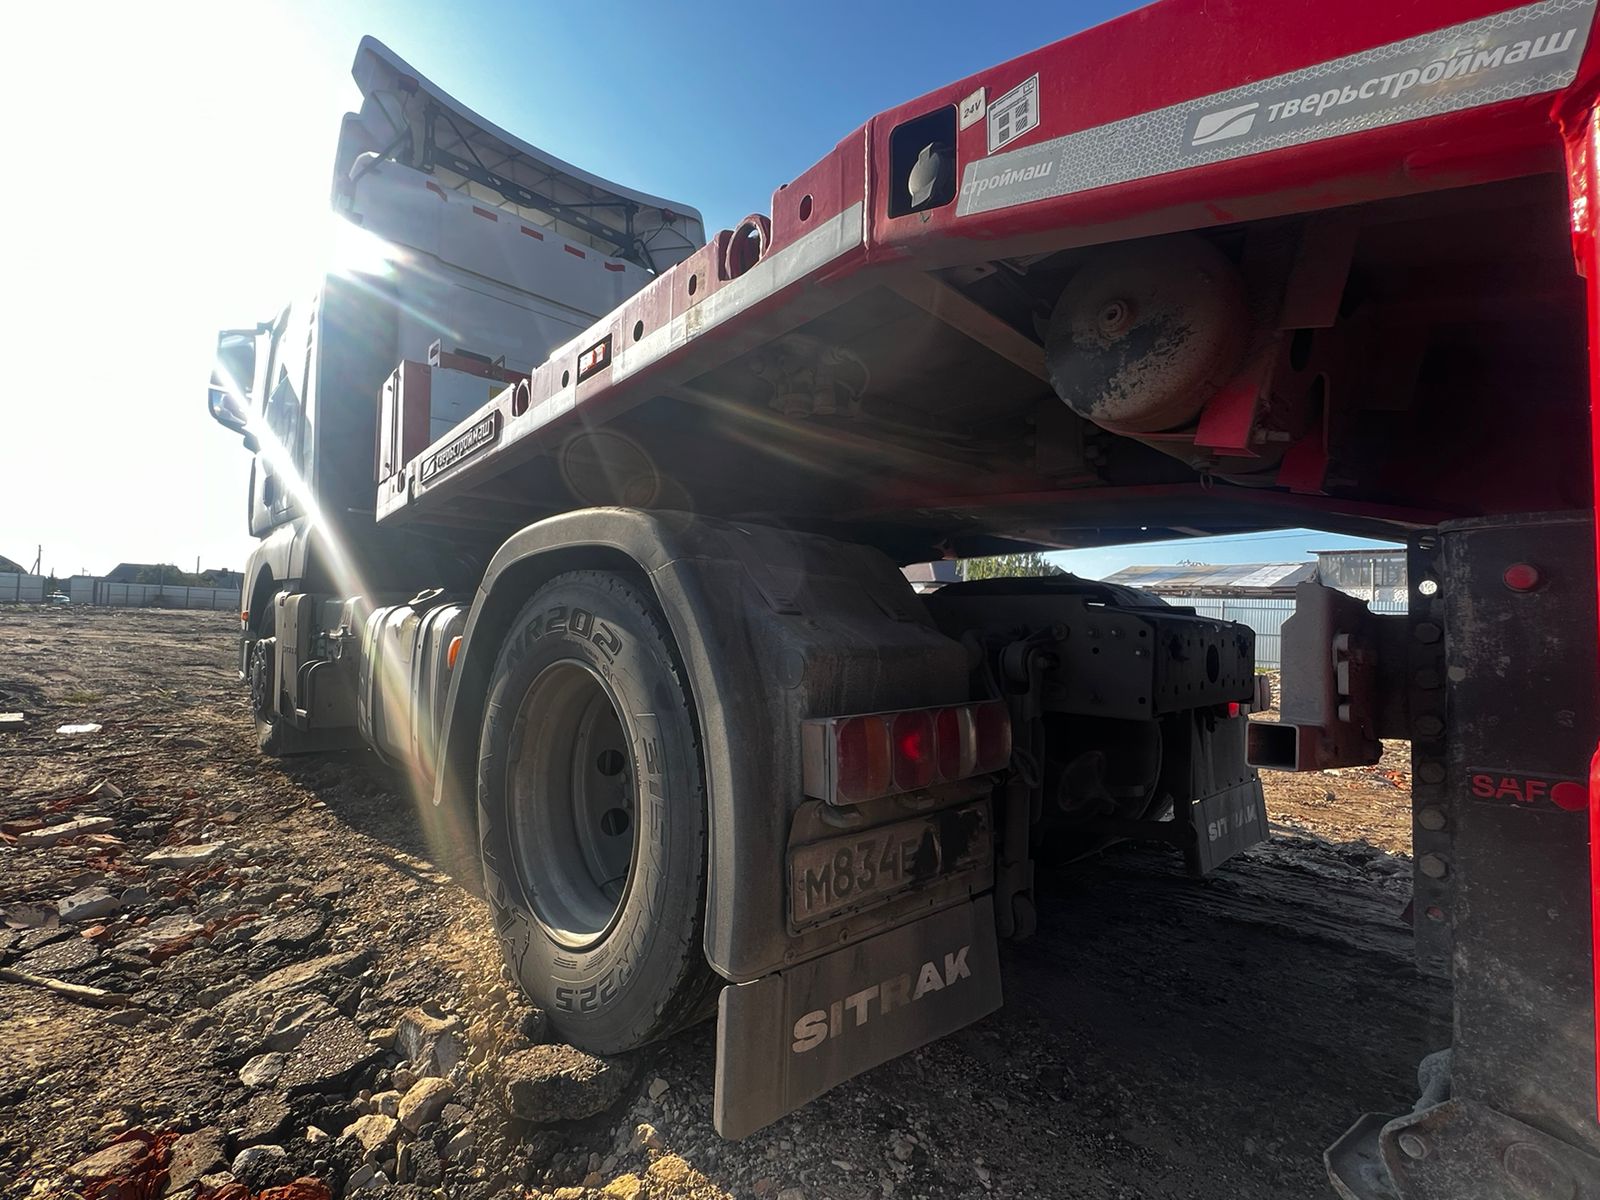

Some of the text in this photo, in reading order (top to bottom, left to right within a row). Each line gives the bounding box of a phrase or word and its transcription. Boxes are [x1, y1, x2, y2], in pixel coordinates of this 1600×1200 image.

[1267, 26, 1578, 125] тверьстроймаш
[963, 100, 982, 119] 24V
[962, 161, 1054, 197] строймаш
[1471, 774, 1548, 803] SAF
[791, 945, 973, 1054] SITRAK
